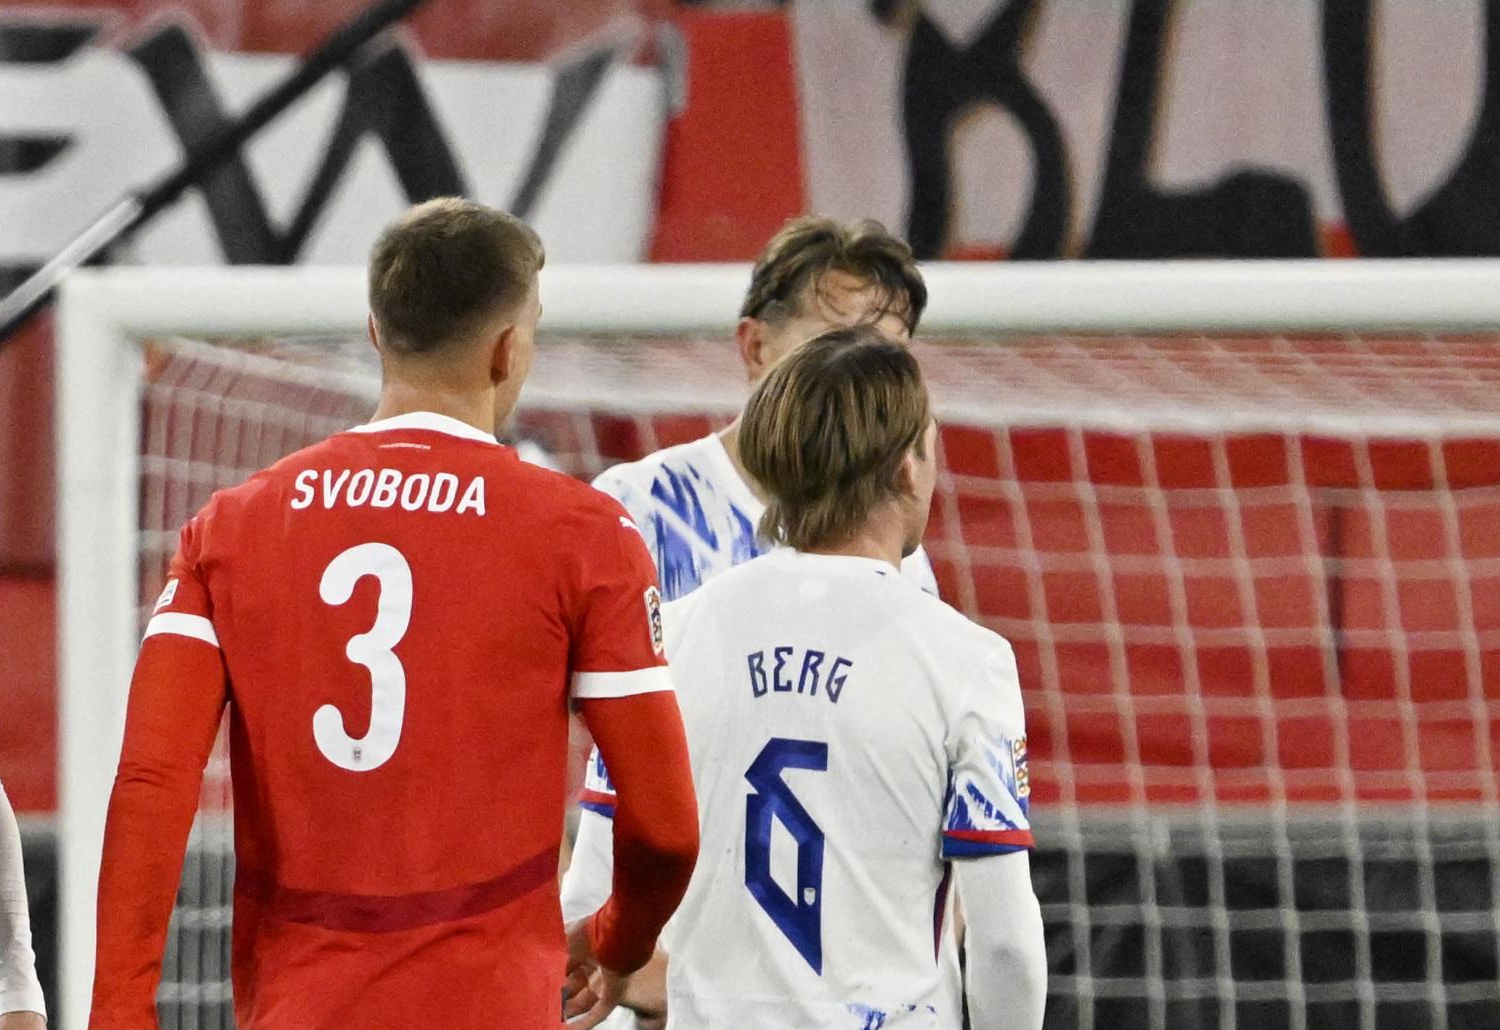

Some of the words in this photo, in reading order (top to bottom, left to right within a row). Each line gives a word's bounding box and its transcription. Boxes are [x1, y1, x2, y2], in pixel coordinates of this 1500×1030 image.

[290, 468, 486, 516] SVOBODA
[312, 542, 413, 772] 3
[748, 647, 853, 704] BERG
[744, 737, 828, 976] 6
